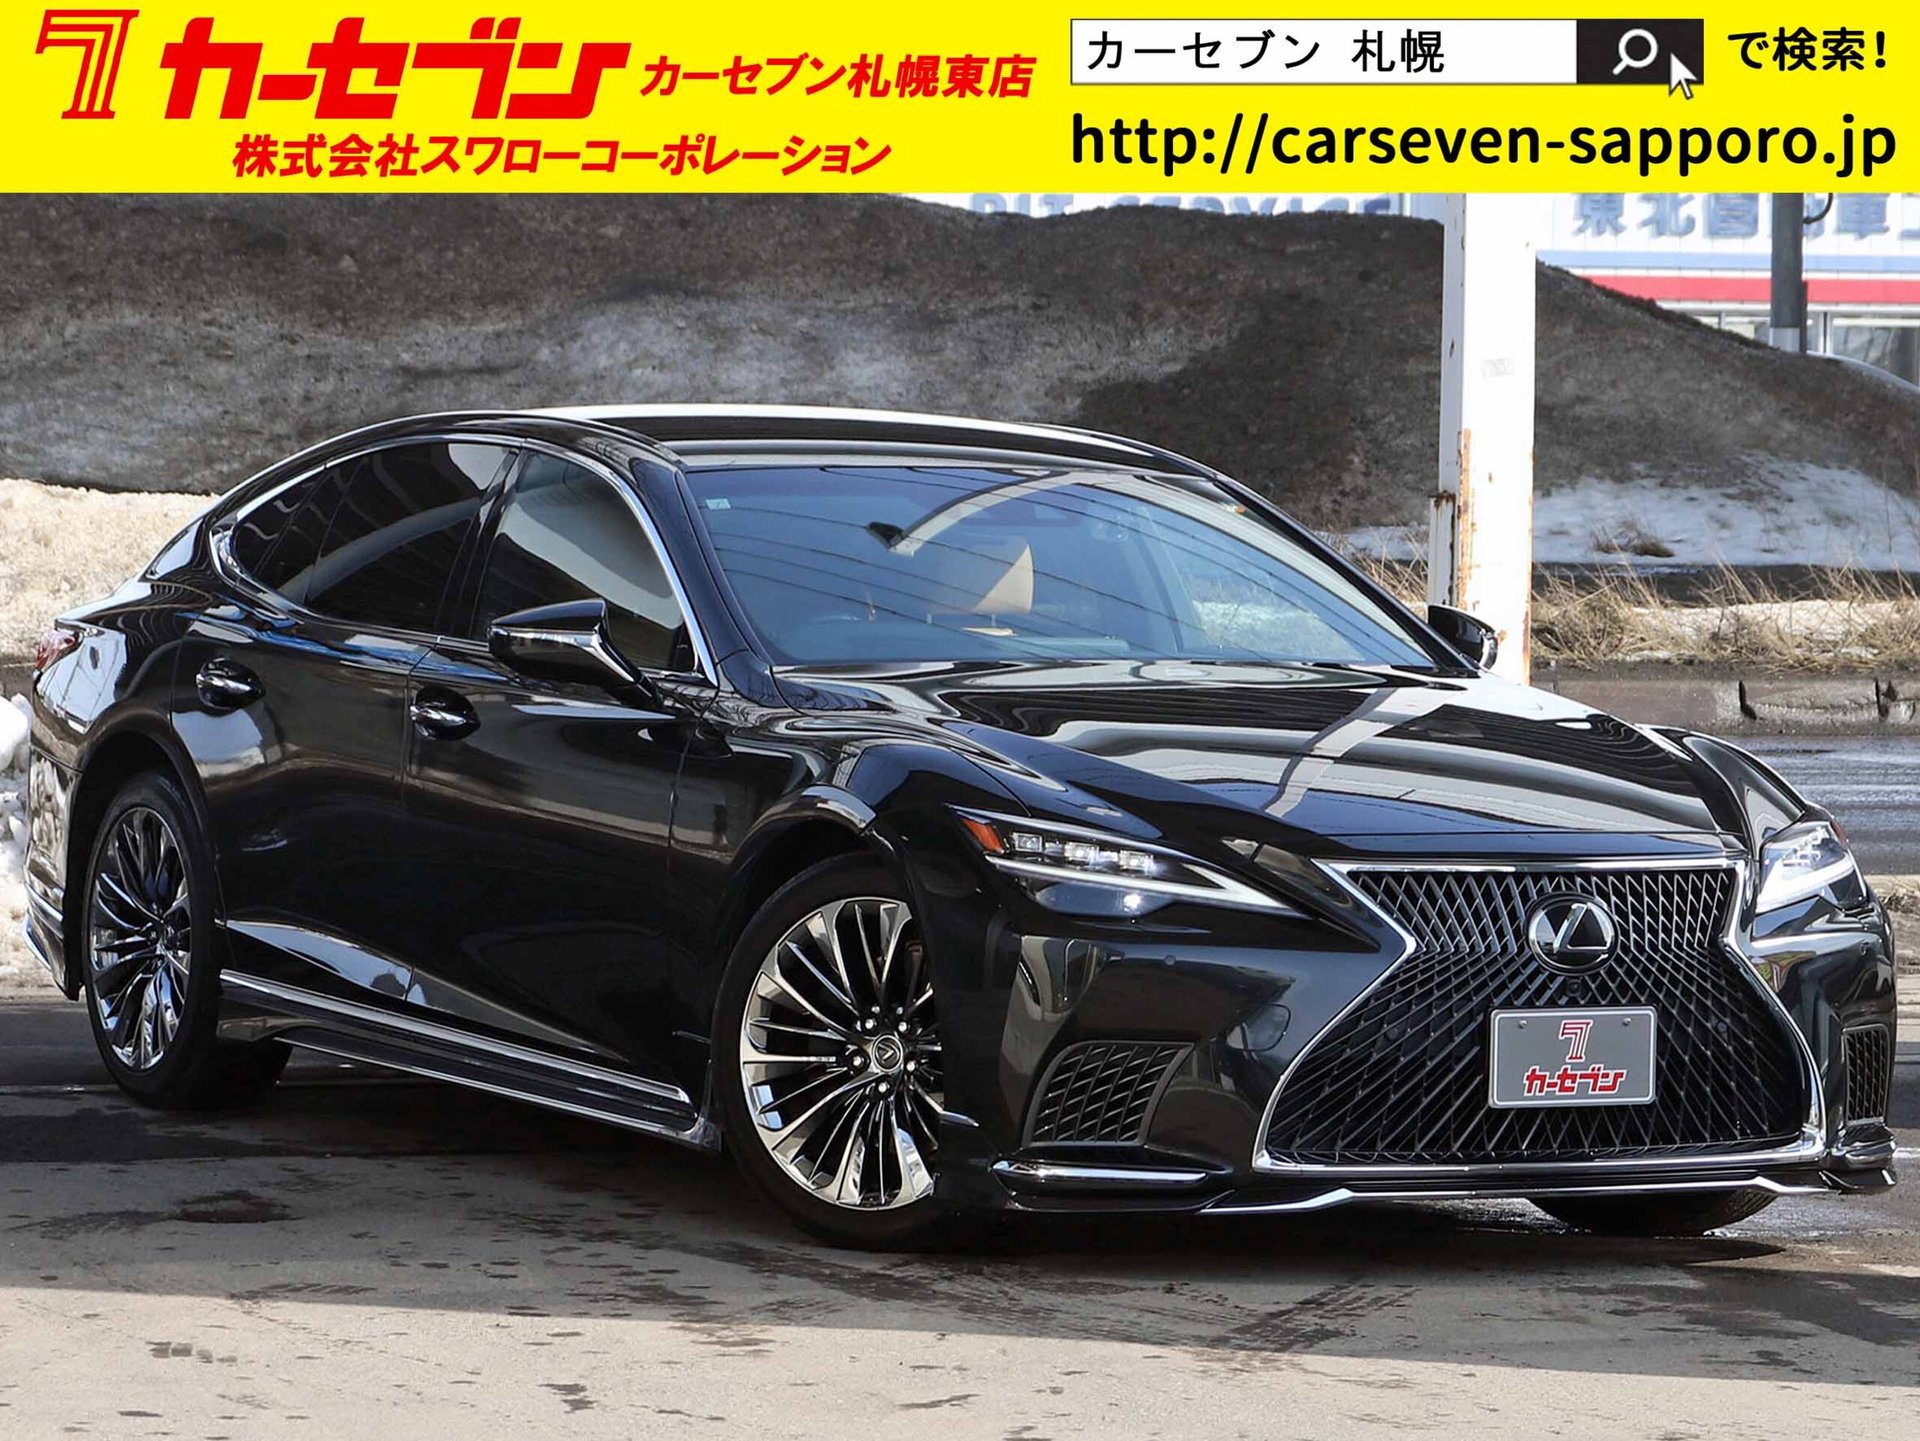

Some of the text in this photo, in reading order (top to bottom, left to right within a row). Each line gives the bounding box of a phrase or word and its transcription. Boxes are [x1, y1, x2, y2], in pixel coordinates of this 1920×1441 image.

[1523, 1064, 1627, 1097] カーセブン
